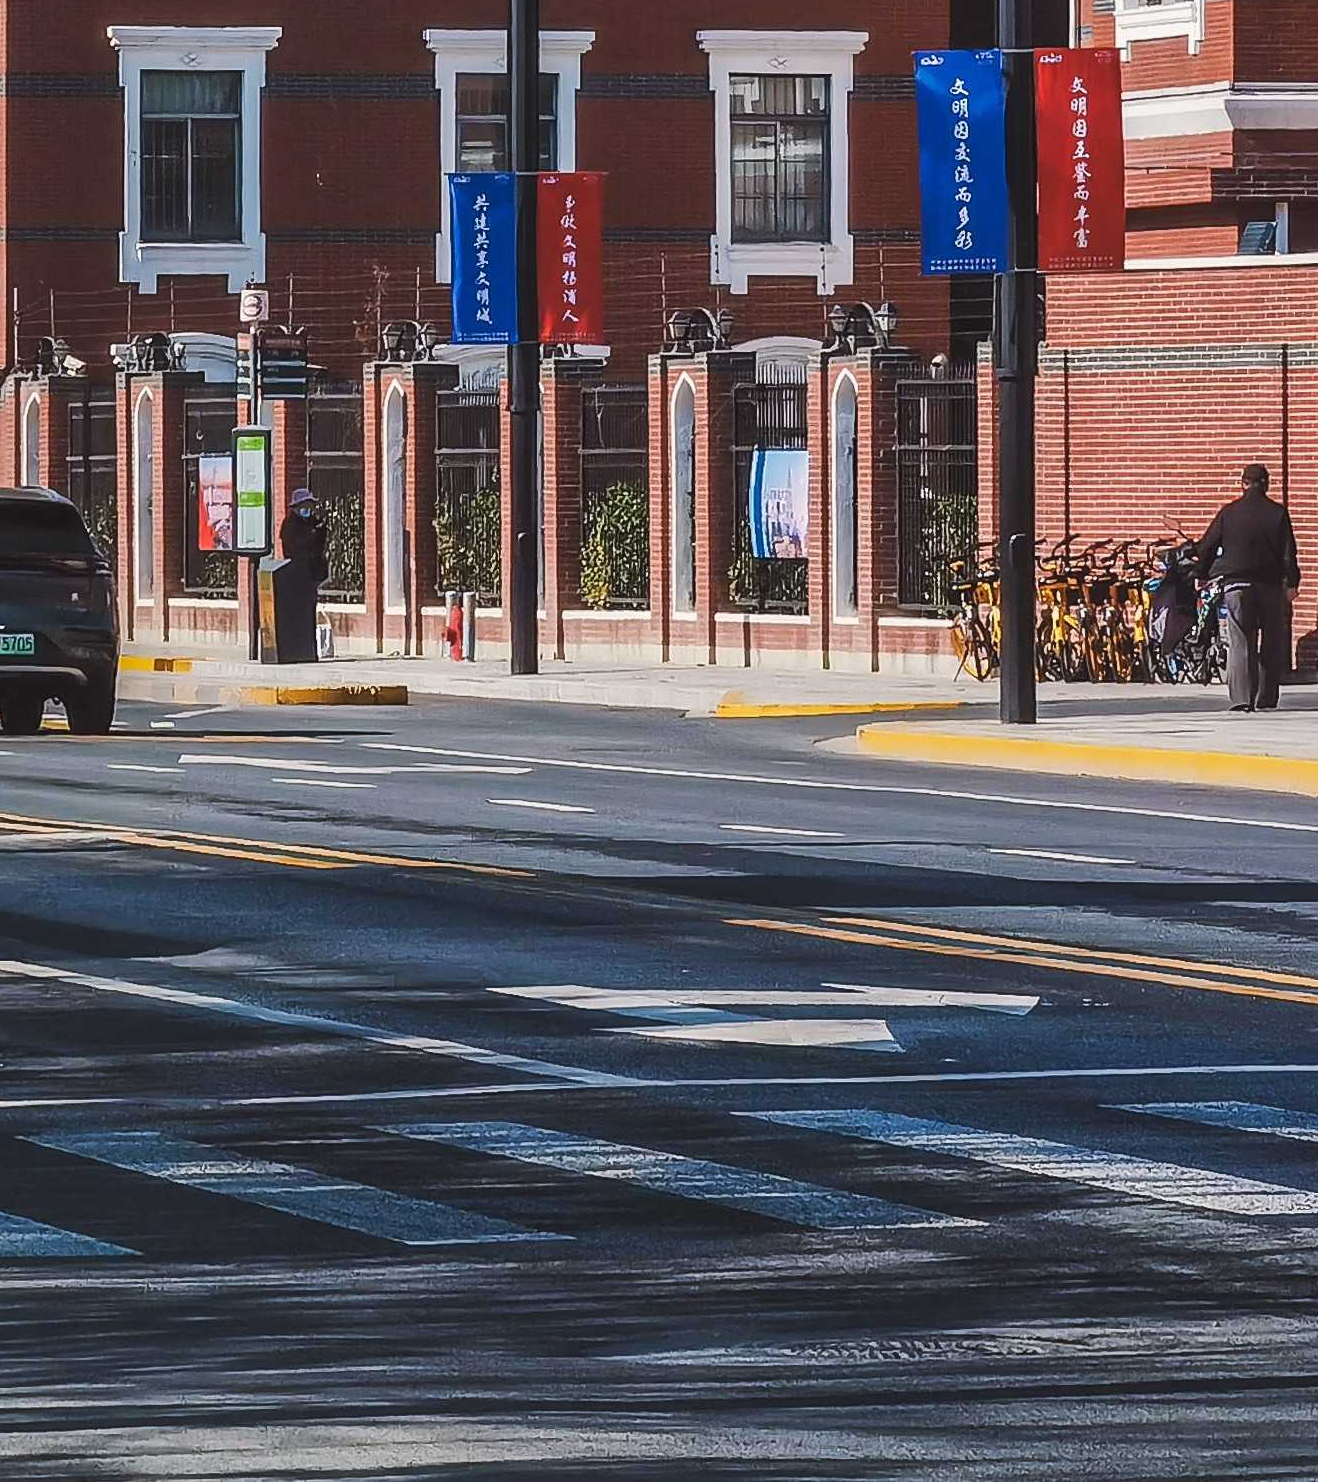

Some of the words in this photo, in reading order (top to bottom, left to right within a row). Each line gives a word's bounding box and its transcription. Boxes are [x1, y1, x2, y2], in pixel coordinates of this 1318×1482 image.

[949, 77, 974, 251] 文明因交流而多彩
[1068, 75, 1092, 249] 文明因互鉴而丰富
[472, 192, 493, 326] 共建共享文明城
[559, 194, 581, 323] 争做文明杨浦人
